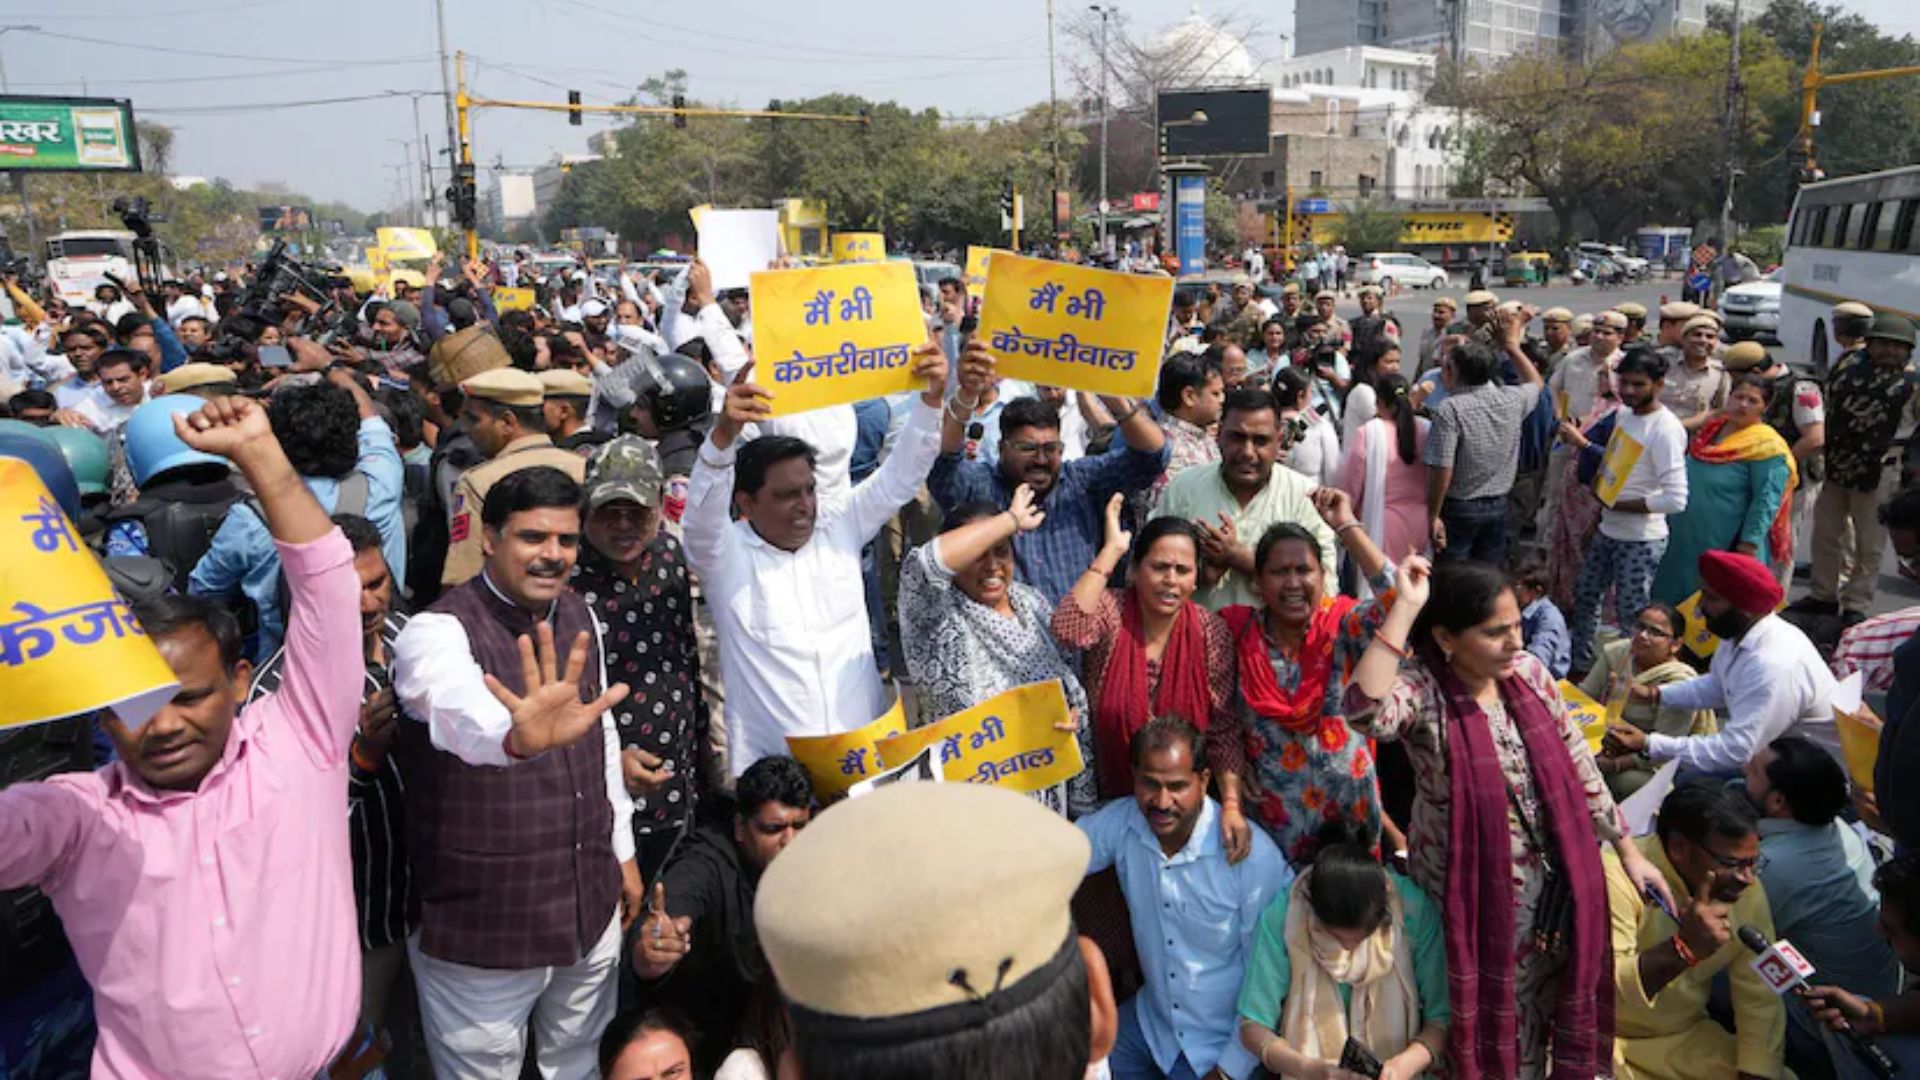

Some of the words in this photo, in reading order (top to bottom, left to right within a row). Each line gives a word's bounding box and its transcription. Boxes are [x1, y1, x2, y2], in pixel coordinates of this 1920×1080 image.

[0, 120, 63, 143] खर
[804, 290, 835, 325] मैं
[841, 286, 872, 320] भी
[1029, 281, 1065, 313] मैं
[1067, 288, 1106, 321] भी
[774, 342, 911, 383] केजरीवाल
[992, 327, 1140, 371] केजरीवाल
[969, 716, 1005, 749] भी
[836, 747, 867, 775] मैं
